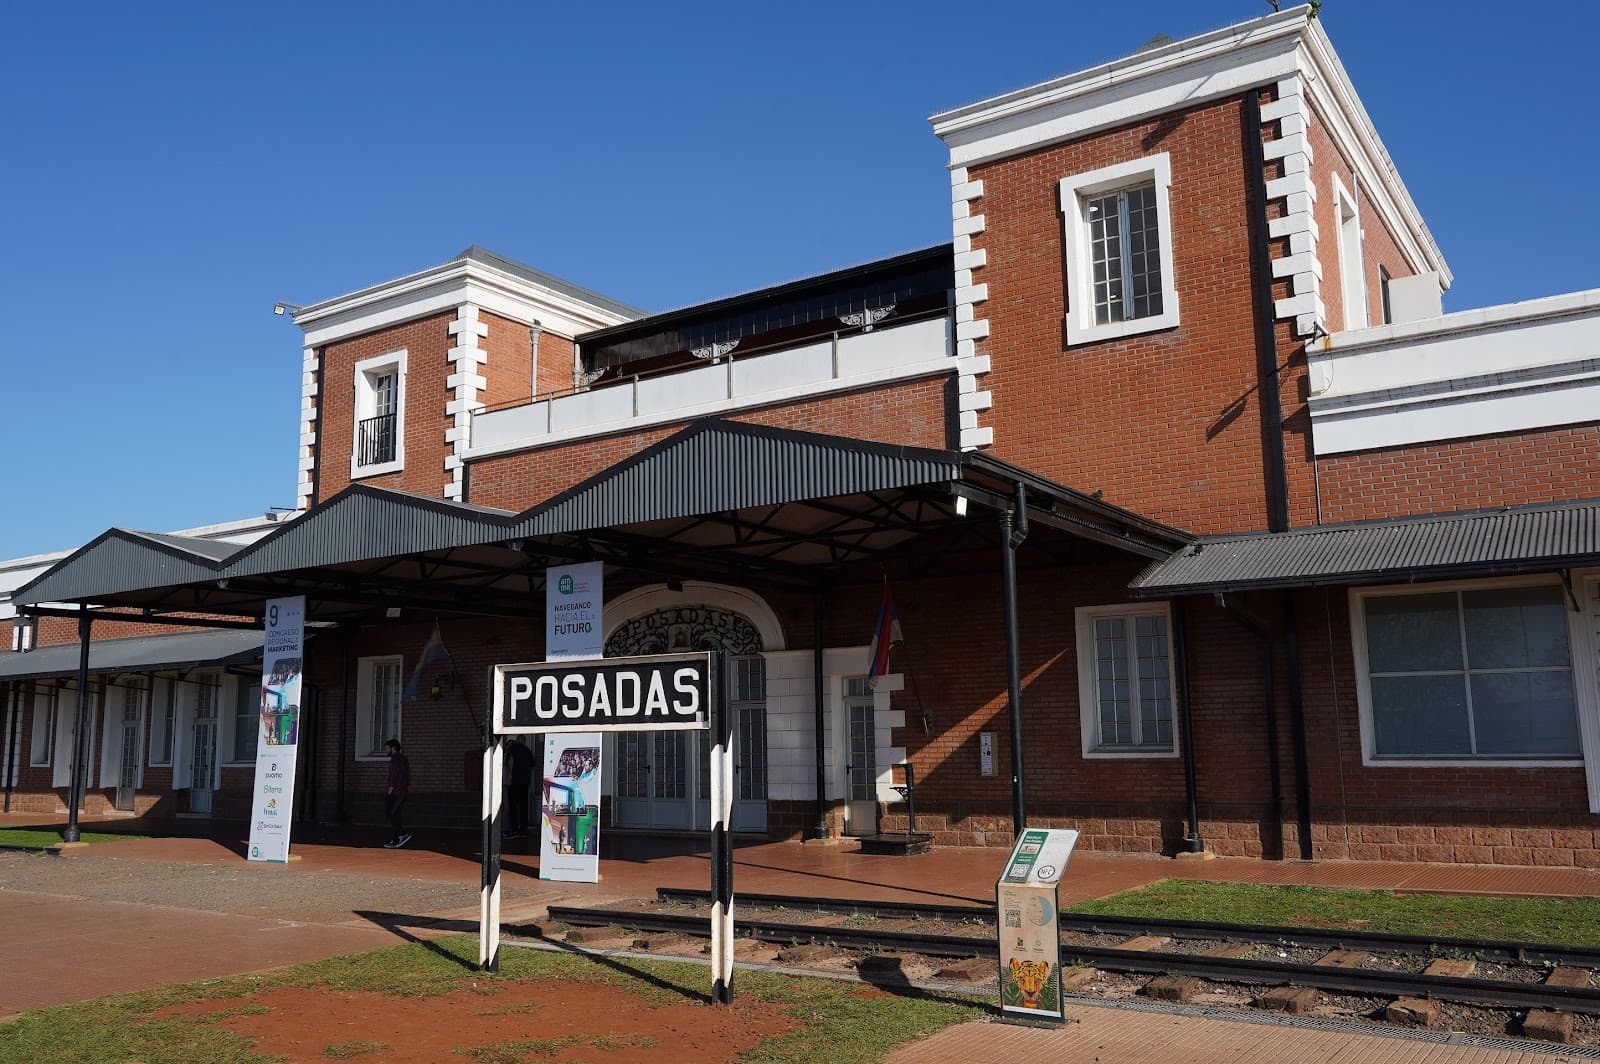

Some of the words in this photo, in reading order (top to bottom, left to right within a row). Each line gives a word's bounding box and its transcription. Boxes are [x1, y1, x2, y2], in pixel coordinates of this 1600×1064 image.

[554, 602, 592, 612] NAVEGANDO
[554, 611, 579, 623] HACIA
[580, 610, 591, 621] EL
[633, 609, 729, 635] POSADAS
[269, 628, 298, 638] CONGRESO
[554, 622, 592, 636] FUTURO
[268, 637, 294, 646] REGIONAL
[268, 644, 298, 653] MARKETING
[510, 667, 700, 720] POSADAS
